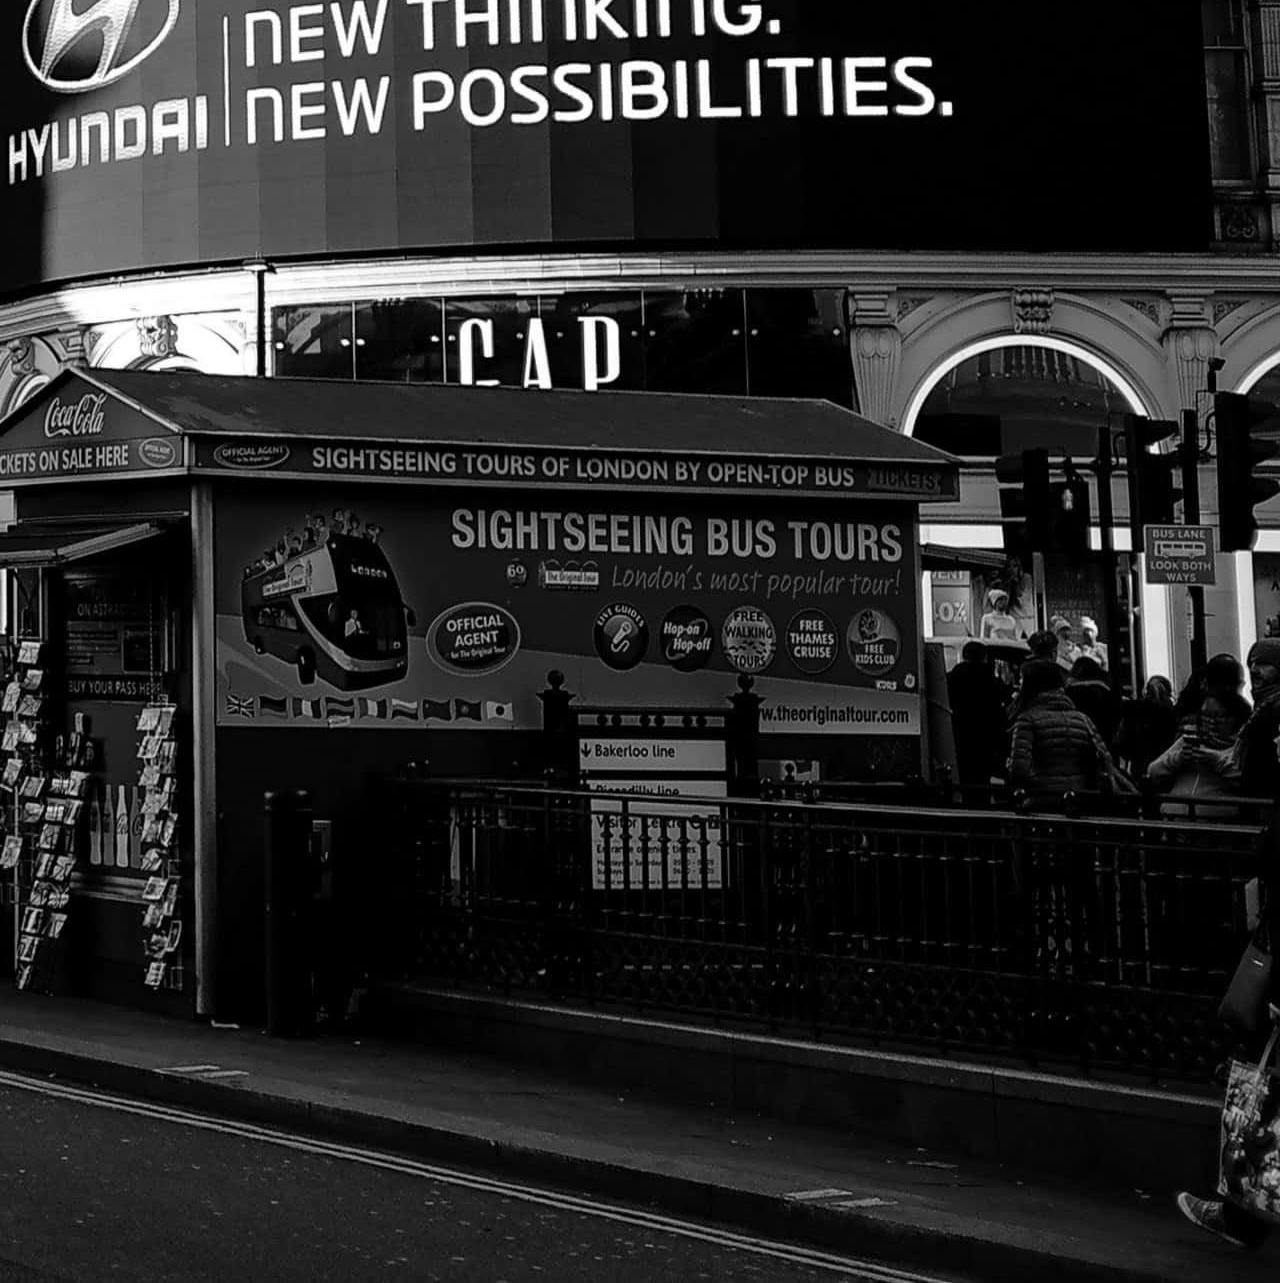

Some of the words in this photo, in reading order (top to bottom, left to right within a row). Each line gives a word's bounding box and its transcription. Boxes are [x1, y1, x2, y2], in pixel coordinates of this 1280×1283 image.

[246, 75, 391, 146] NEW
[412, 56, 955, 130] POSSIBILITIES.
[7, 94, 209, 186] HYUNDAI
[458, 316, 621, 392] GAP
[45, 392, 108, 439] Coca-Cola
[40, 450, 58, 471] ON
[62, 447, 92, 469] SALE
[95, 443, 129, 467] HERE
[312, 445, 456, 475] SIGHTSEEING
[462, 452, 536, 477] TOURS
[541, 454, 571, 478] OF
[576, 456, 669, 482] LONDON
[674, 460, 701, 482] BY
[707, 460, 810, 486] OPEN-TOP
[814, 464, 856, 488] BUS
[869, 466, 936, 490] TICKETS
[451, 507, 694, 558] SIGHTSEEING
[705, 514, 777, 561] BUS
[789, 519, 905, 564] TOURS
[1152, 528, 1175, 539] BUS
[1178, 529, 1207, 540] LANE
[1150, 560, 1180, 572] LOOK
[1182, 560, 1212, 573] BOTH
[611, 564, 705, 593] London's
[711, 568, 762, 595] most
[765, 568, 845, 603] popular
[848, 567, 902, 598] tour!
[1167, 573, 1197, 583] WAYS
[446, 614, 504, 633] OFFICIAL
[596, 607, 614, 628] LIVE
[613, 603, 645, 628] GUIDES
[734, 611, 763, 622] FREE
[663, 620, 701, 638] Hop-on
[725, 626, 773, 639] WALKING
[799, 619, 825, 632] FREE
[454, 629, 500, 649] AGENT
[673, 636, 713, 655] Hop-off
[789, 632, 835, 646] THAMES
[793, 645, 832, 659] CRUISE
[864, 643, 885, 655] FREE
[734, 654, 767, 667] TOURS
[855, 653, 873, 666] KIDS
[874, 653, 896, 666] CLUB
[68, 679, 87, 694] BUY
[88, 679, 114, 695] YOUR
[115, 679, 137, 696] PASS
[759, 706, 909, 725] w.theoriginaltour.com
[595, 744, 649, 758] Bakerloo
[652, 744, 675, 758] line
